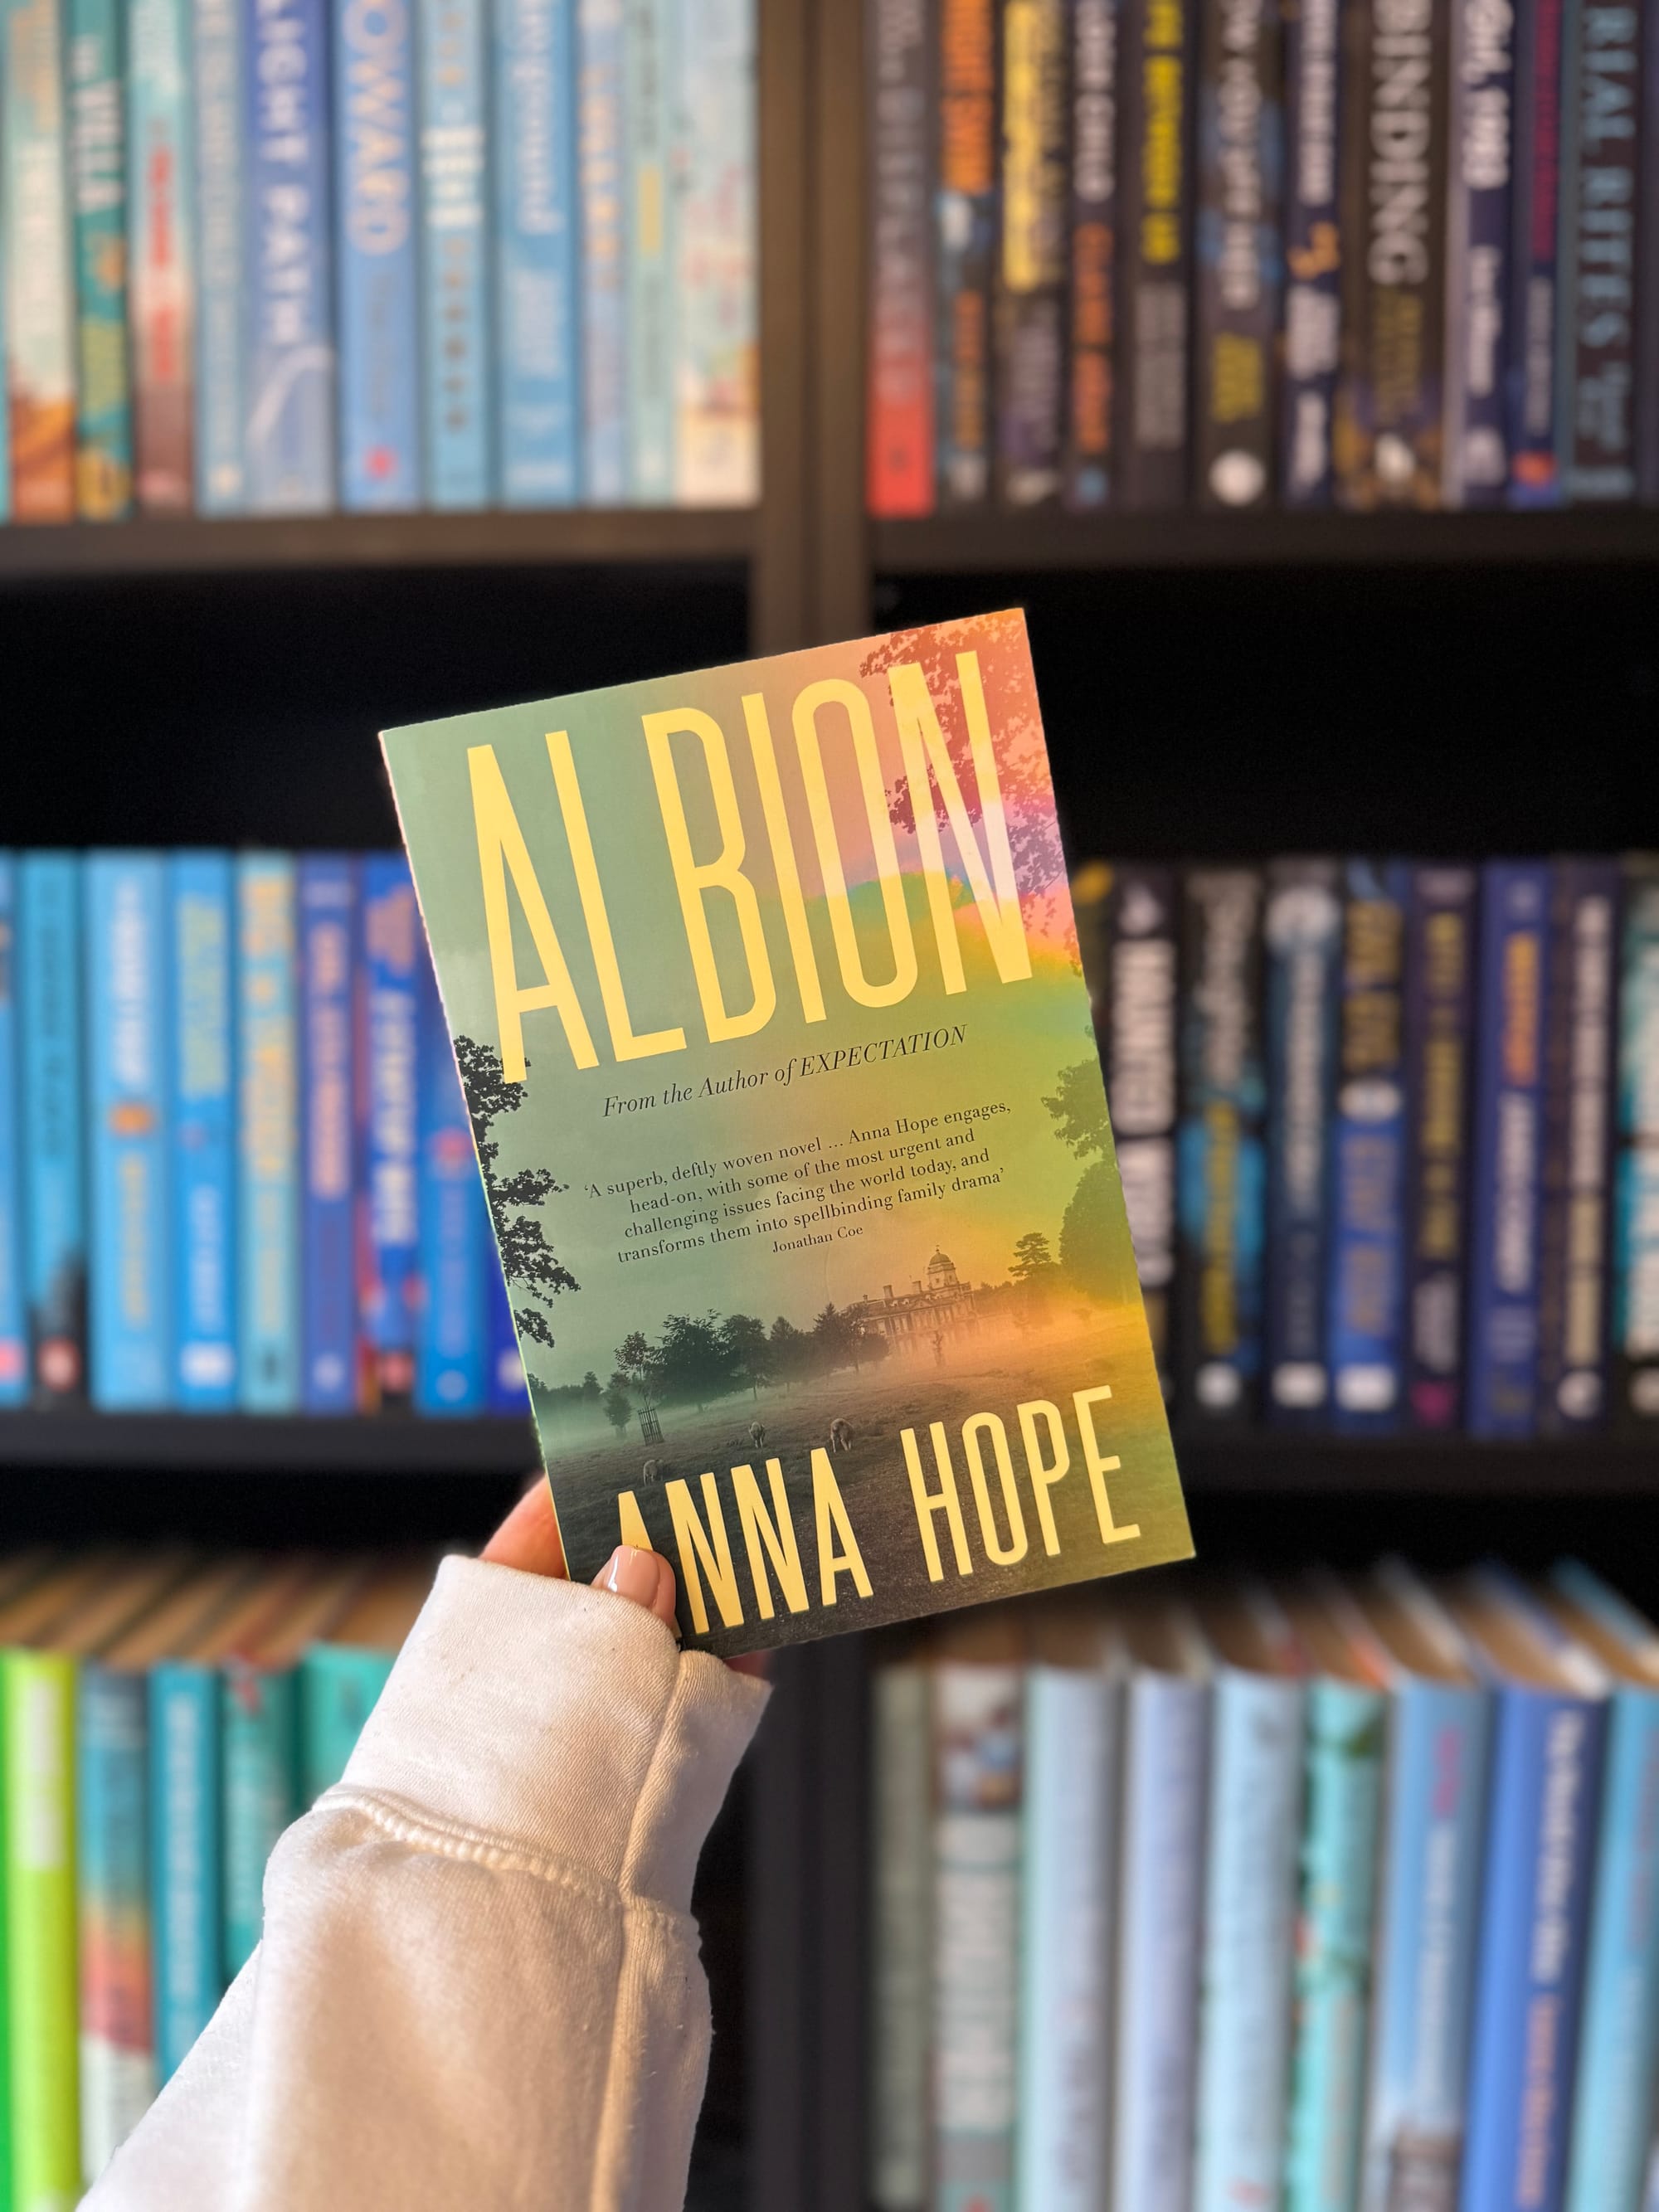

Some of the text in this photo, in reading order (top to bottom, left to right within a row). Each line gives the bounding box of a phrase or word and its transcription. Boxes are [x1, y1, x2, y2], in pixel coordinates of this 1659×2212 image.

[263, 184, 310, 345] PATH
[468, 650, 1032, 1083] ALBION
[602, 1024, 967, 1117] From the Author of EXPECTATION
[607, 1171, 667, 1195] superb,
[672, 1160, 717, 1180] deftly
[723, 1152, 773, 1169] woven
[778, 1137, 821, 1158] novel
[849, 1127, 891, 1144] Anna
[894, 1117, 938, 1134] Hope
[944, 1103, 1010, 1124] engages,
[625, 1148, 989, 1237] challenging issues facing the world today, and
[630, 1128, 975, 1213] head-on, with some of the most urgent and
[618, 1237, 704, 1262] transforms
[711, 1227, 750, 1242] them
[757, 1218, 787, 1233] into
[794, 1196, 893, 1228] spellbinding
[898, 1182, 946, 1203] family
[773, 1227, 863, 1252] Jonathan Coe
[900, 1385, 1141, 1582] HOPE
